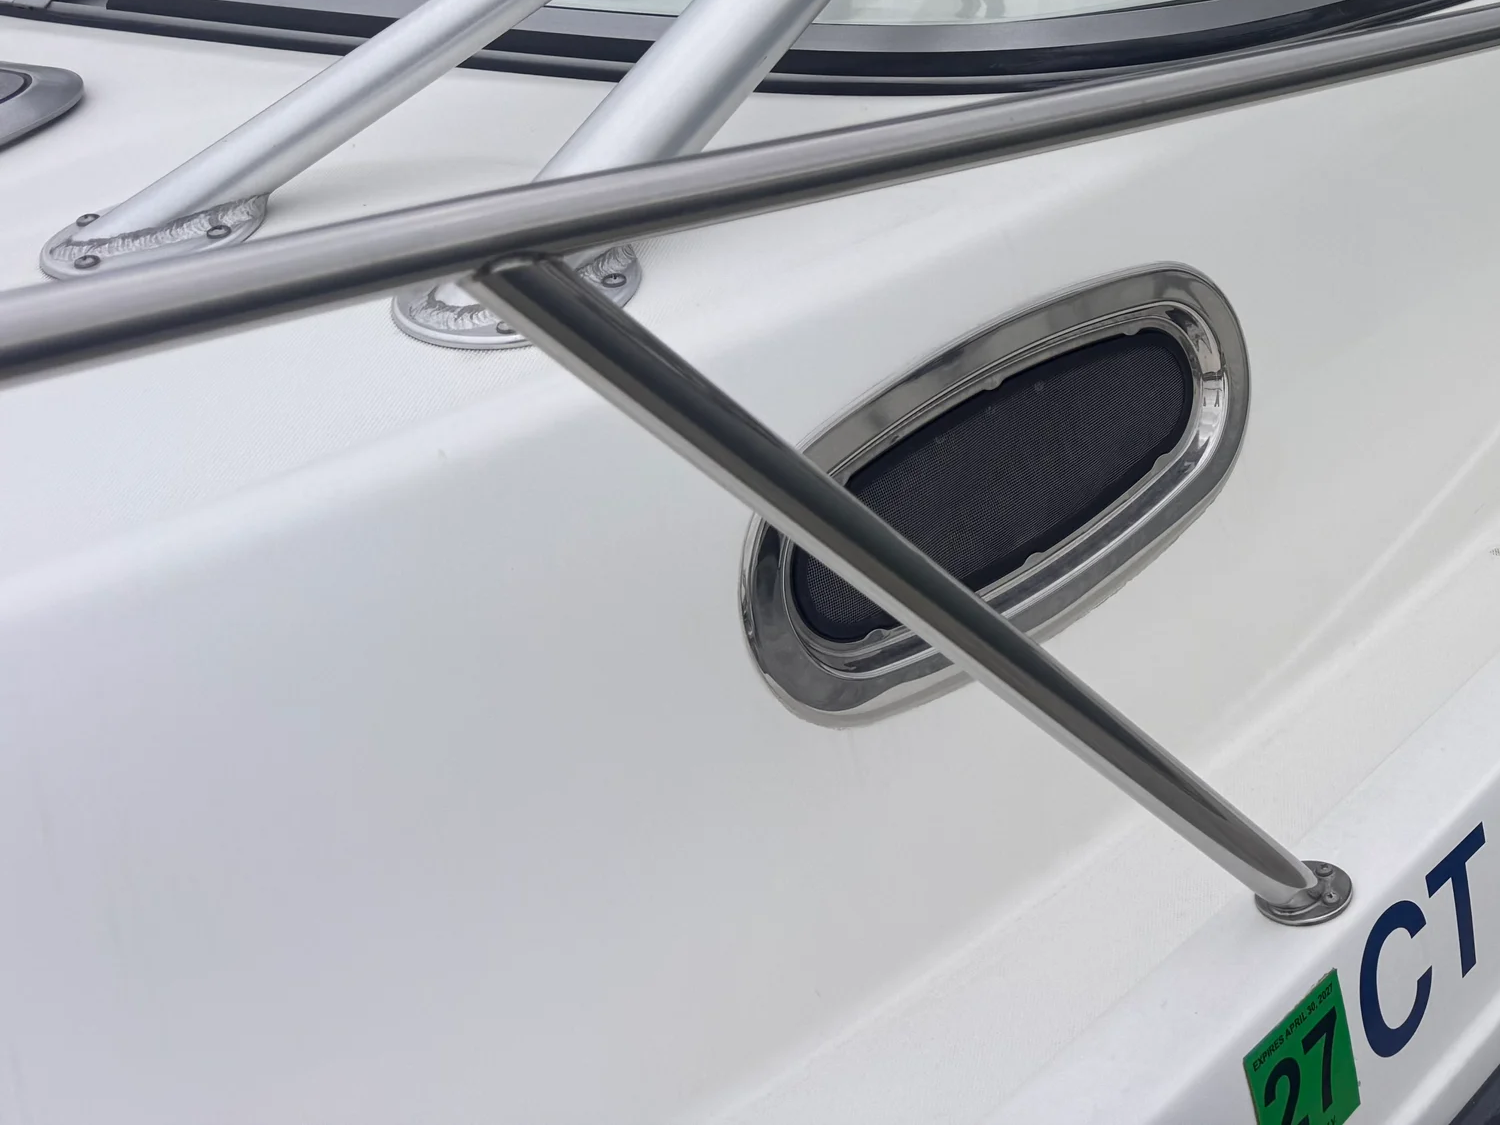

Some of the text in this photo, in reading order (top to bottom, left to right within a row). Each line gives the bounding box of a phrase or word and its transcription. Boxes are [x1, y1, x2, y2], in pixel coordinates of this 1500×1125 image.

[1359, 821, 1486, 1058] CT
[1252, 1035, 1285, 1072] EXPIRES
[1285, 1011, 1307, 1038] APRIL
[1318, 981, 1333, 1005] 2027
[1264, 1006, 1337, 1125] 27
